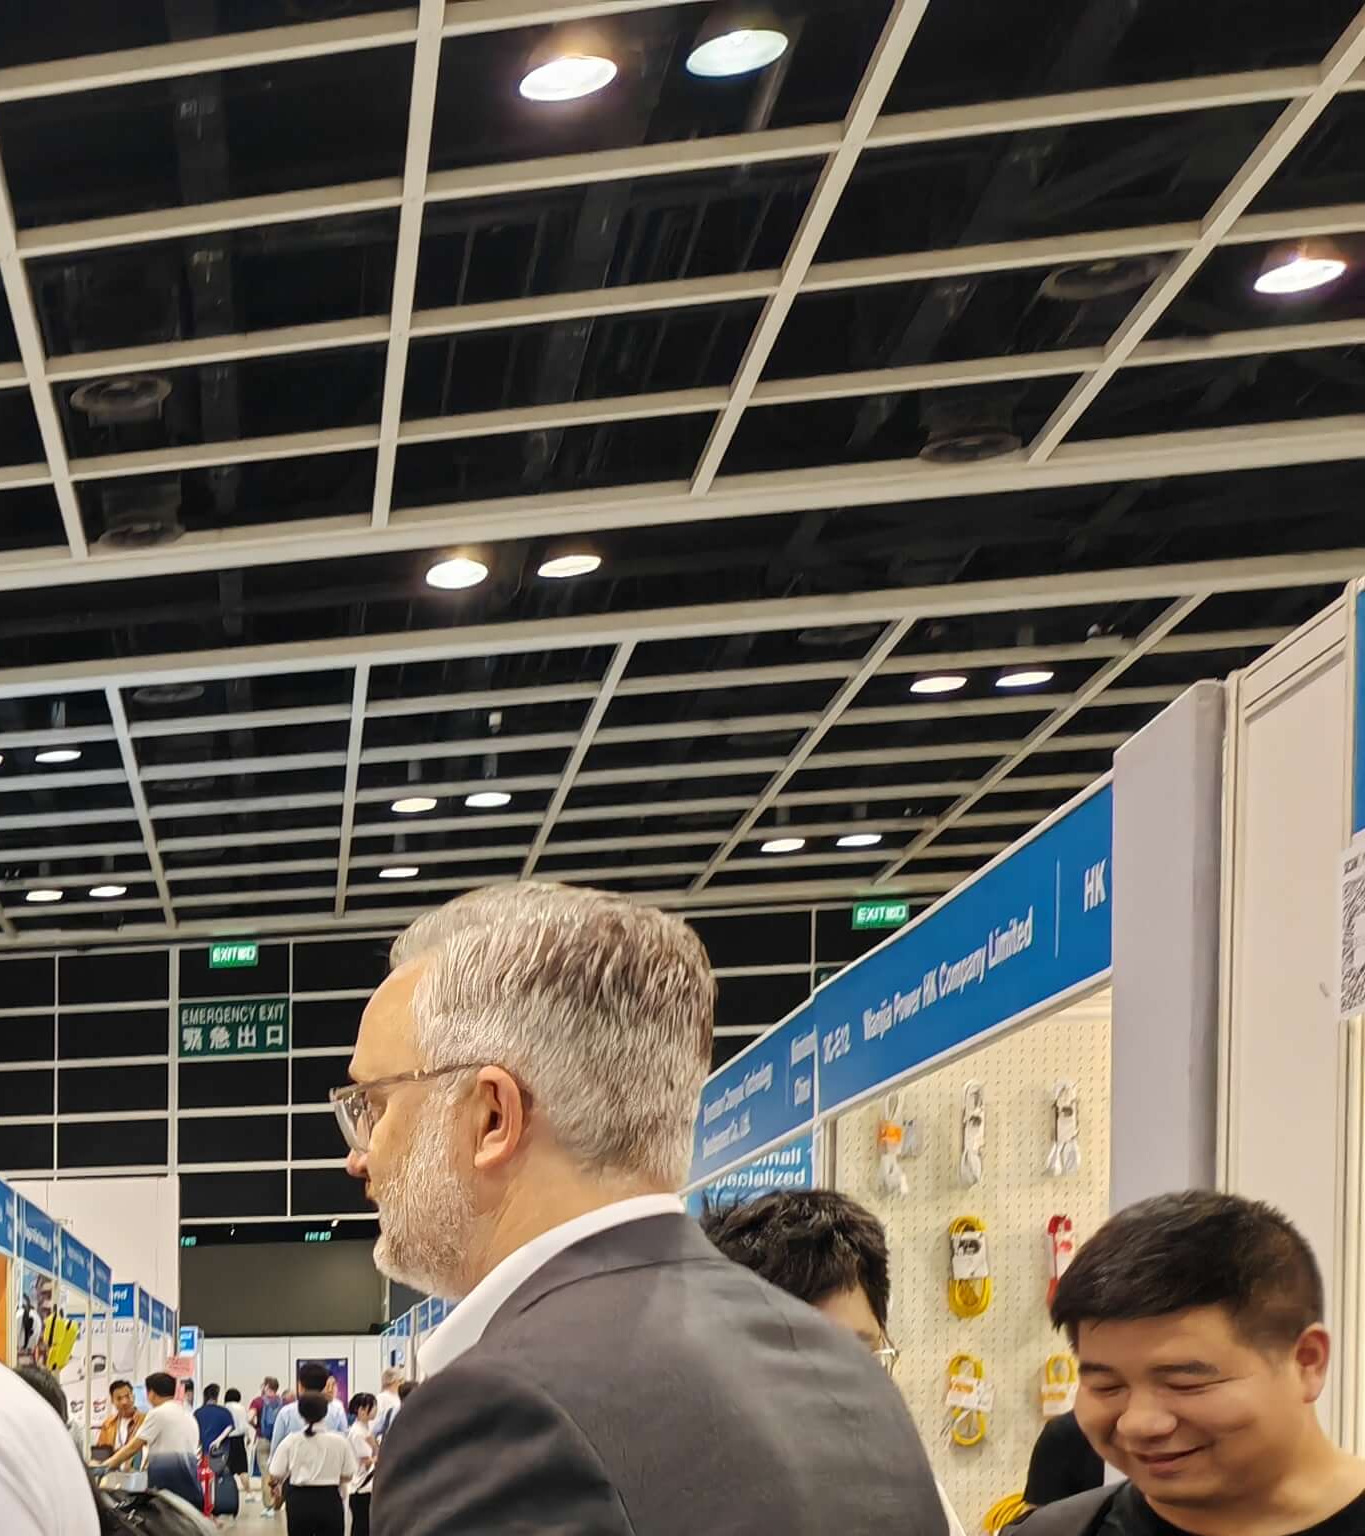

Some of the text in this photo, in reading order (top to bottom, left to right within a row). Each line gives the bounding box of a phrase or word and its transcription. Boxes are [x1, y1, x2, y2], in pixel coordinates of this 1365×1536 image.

[1083, 857, 1107, 913] HK
[856, 905, 885, 923] EXIT
[212, 945, 237, 962] EXIT
[938, 943, 987, 995] Company
[987, 904, 1034, 971] Limited
[181, 1002, 286, 1026] EMERGENCY EXIT
[752, 1146, 802, 1168] mall
[711, 1167, 806, 1191] pecialized
